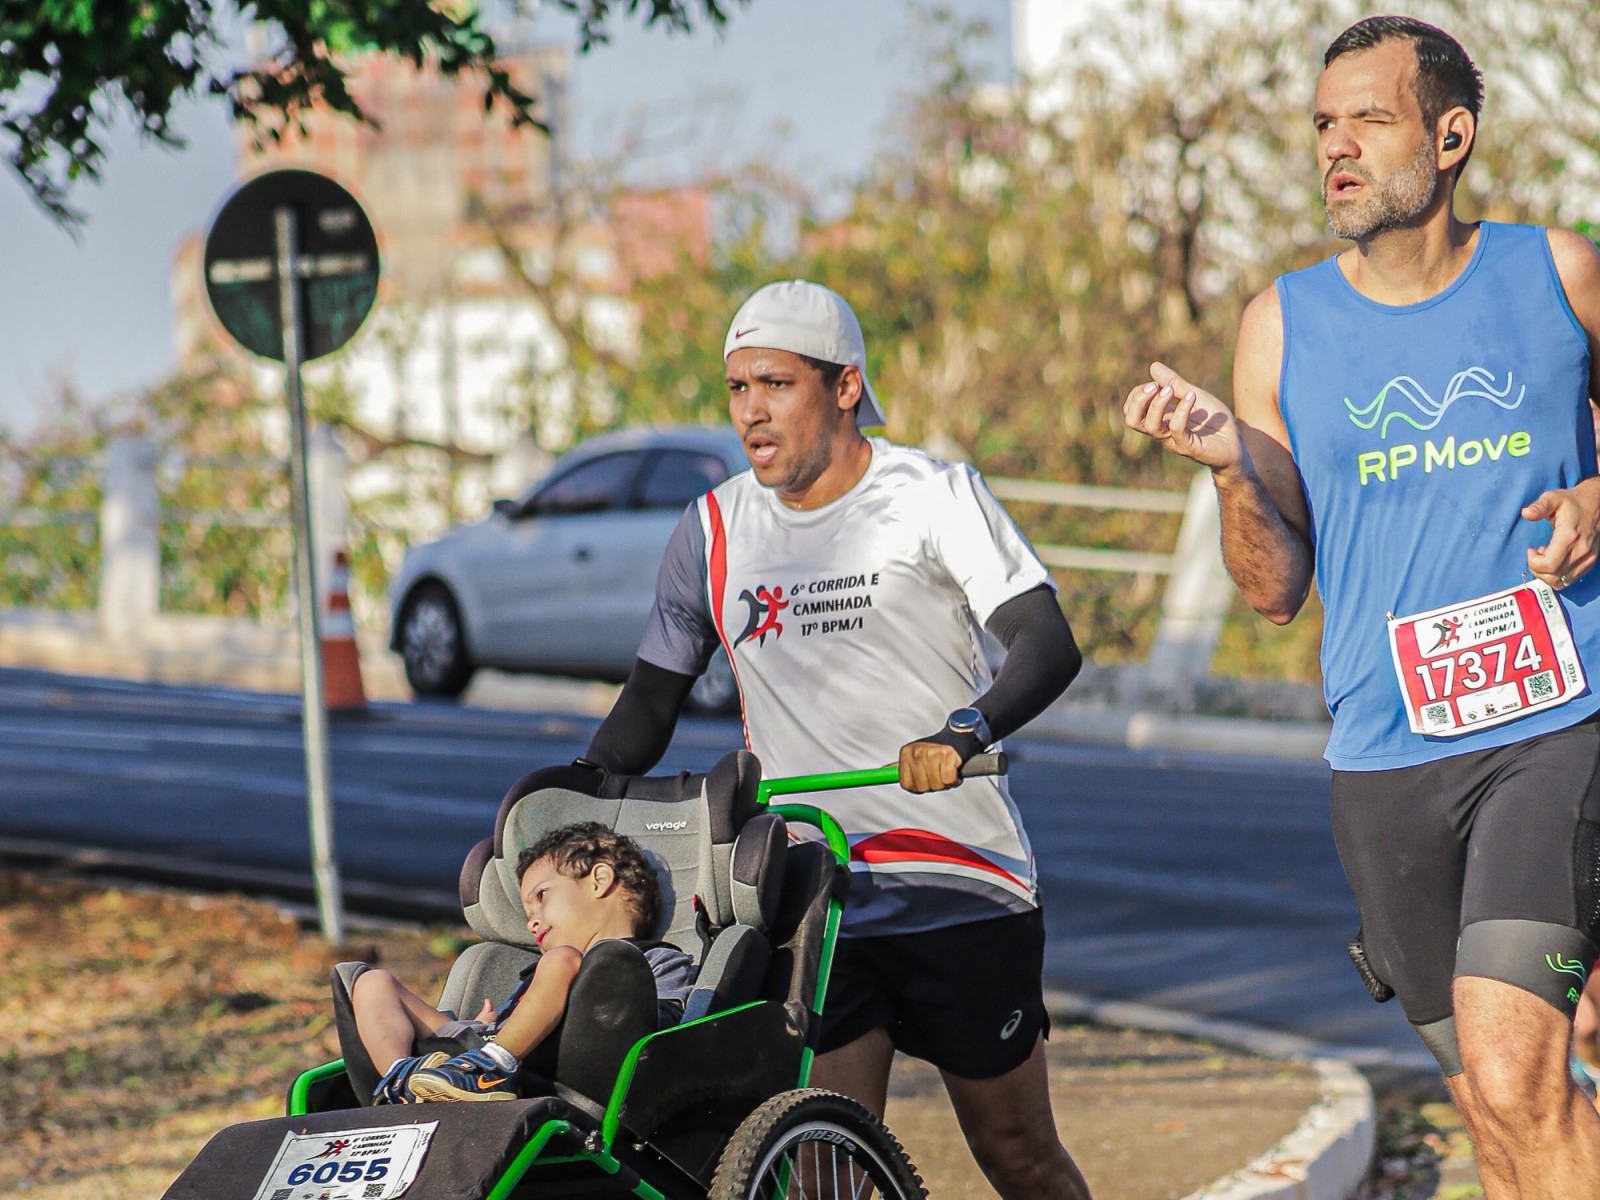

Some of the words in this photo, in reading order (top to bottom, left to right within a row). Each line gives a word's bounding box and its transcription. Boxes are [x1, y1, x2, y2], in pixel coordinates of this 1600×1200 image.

[1357, 444, 1418, 486] RP
[1424, 431, 1532, 474] Move
[808, 575, 866, 594] CORRIDA
[871, 573, 879, 586] E
[793, 595, 873, 616] CAMINHADA
[1474, 602, 1508, 616] CORRIDA
[1542, 589, 1553, 609] 17374
[822, 617, 863, 633] BPM/I
[1486, 621, 1517, 637] BPM/I
[1415, 634, 1543, 701] 17374
[645, 821, 687, 832] voyage
[287, 1157, 391, 1186] 6055
